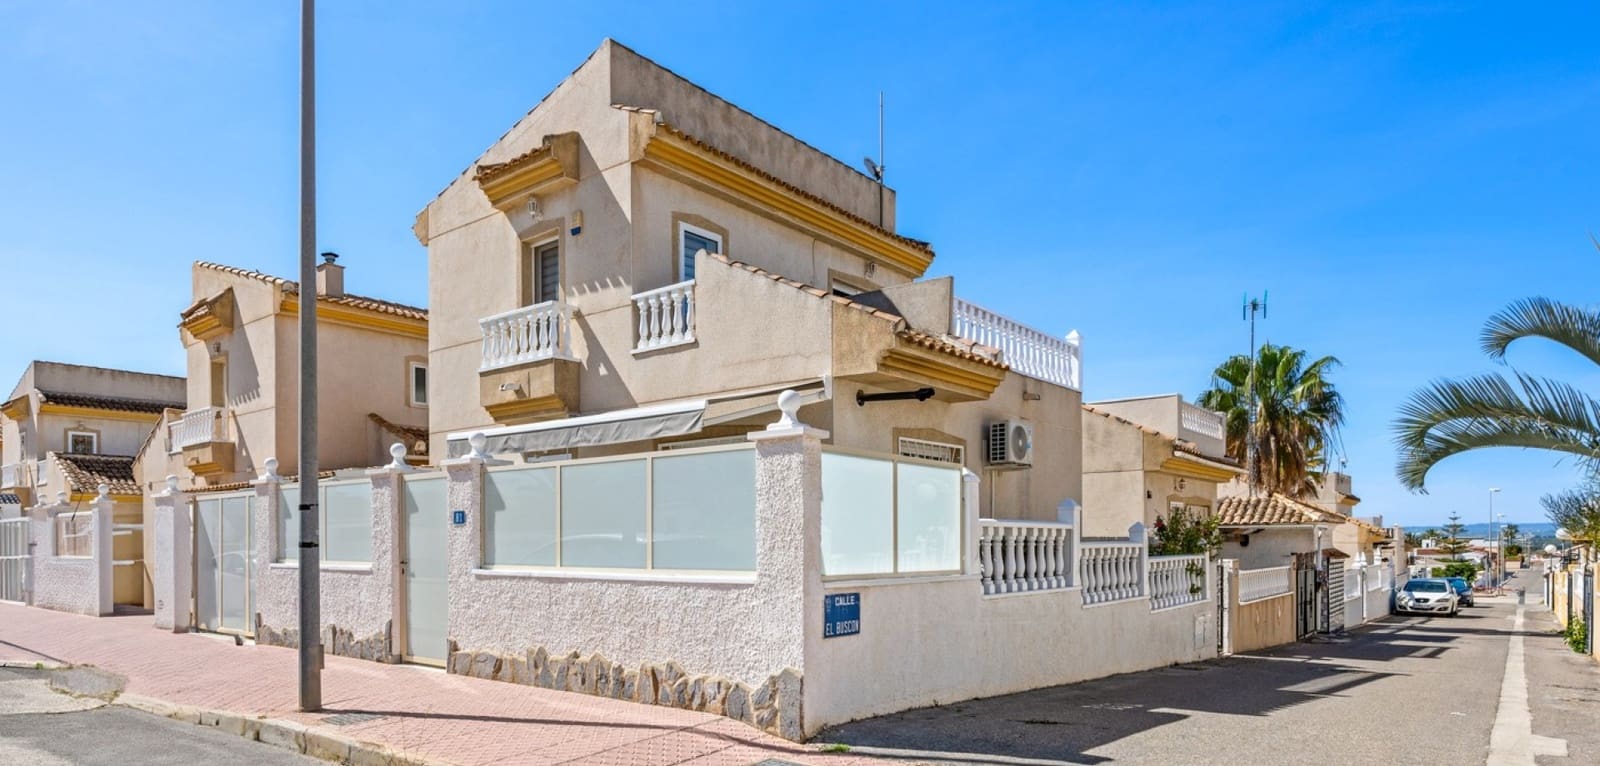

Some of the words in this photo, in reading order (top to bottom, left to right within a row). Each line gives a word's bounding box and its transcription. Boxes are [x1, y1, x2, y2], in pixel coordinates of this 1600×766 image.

[835, 596, 855, 606] CALLE
[826, 623, 834, 636] EL
[836, 620, 859, 634] BUSCON
